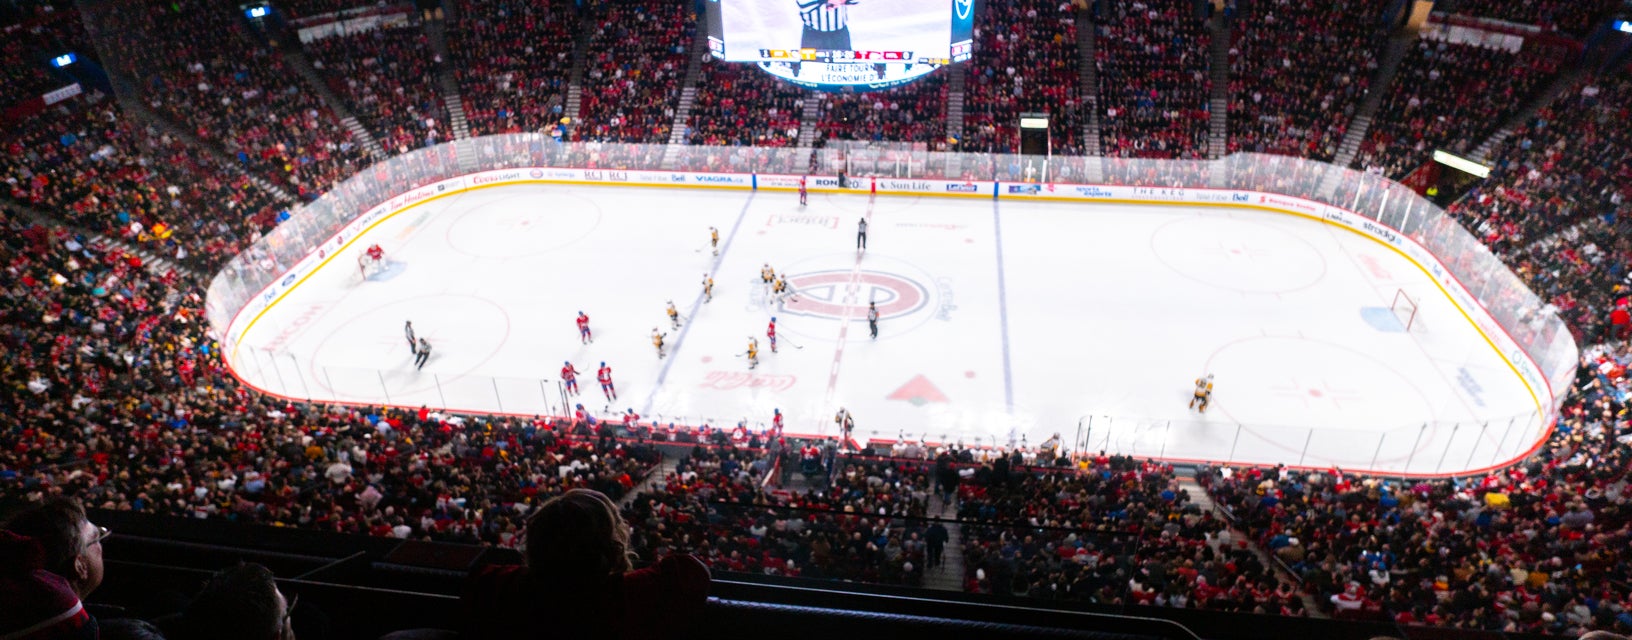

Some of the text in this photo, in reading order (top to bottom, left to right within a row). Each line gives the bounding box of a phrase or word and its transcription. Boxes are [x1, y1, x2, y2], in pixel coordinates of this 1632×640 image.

[890, 181, 931, 191] Sun Life
[1132, 187, 1154, 195] THE
